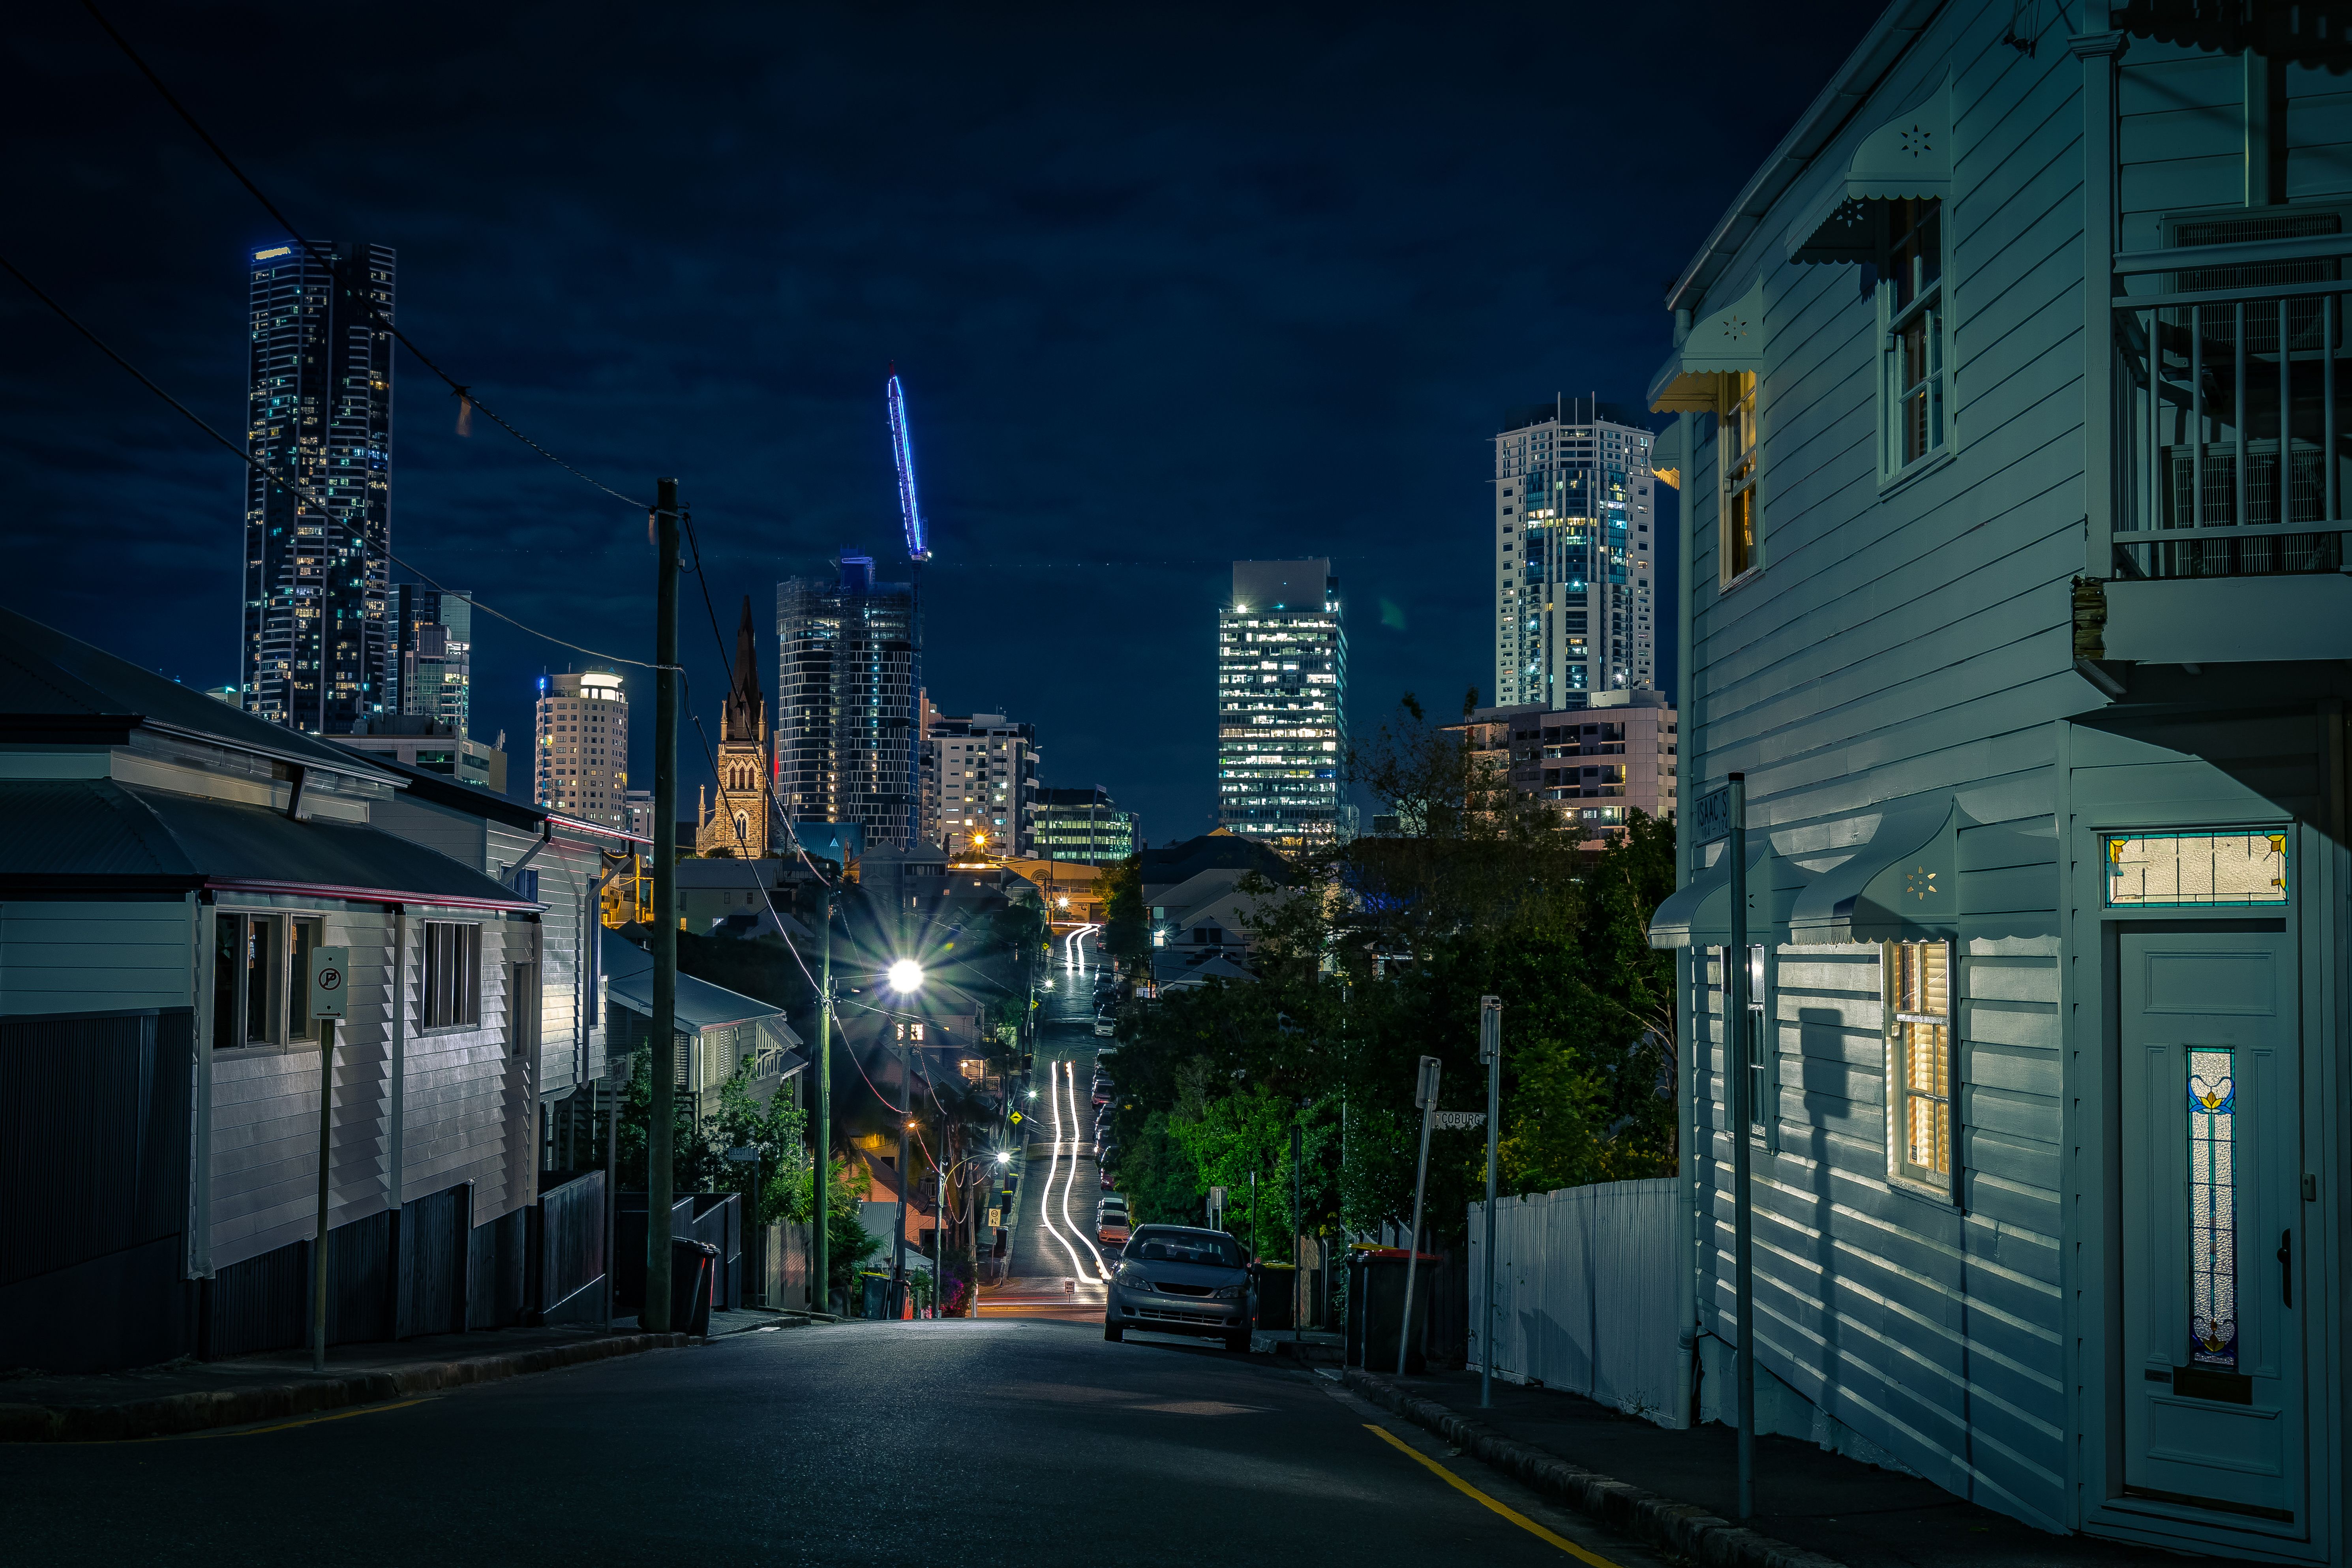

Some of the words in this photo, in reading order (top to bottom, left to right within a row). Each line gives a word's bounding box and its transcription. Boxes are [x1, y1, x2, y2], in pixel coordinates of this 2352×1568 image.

[1697, 795, 1718, 827] ISAAC
[1722, 790, 1728, 818] S
[1718, 818, 1728, 834] 124
[1442, 1113, 1480, 1124] COBURG
